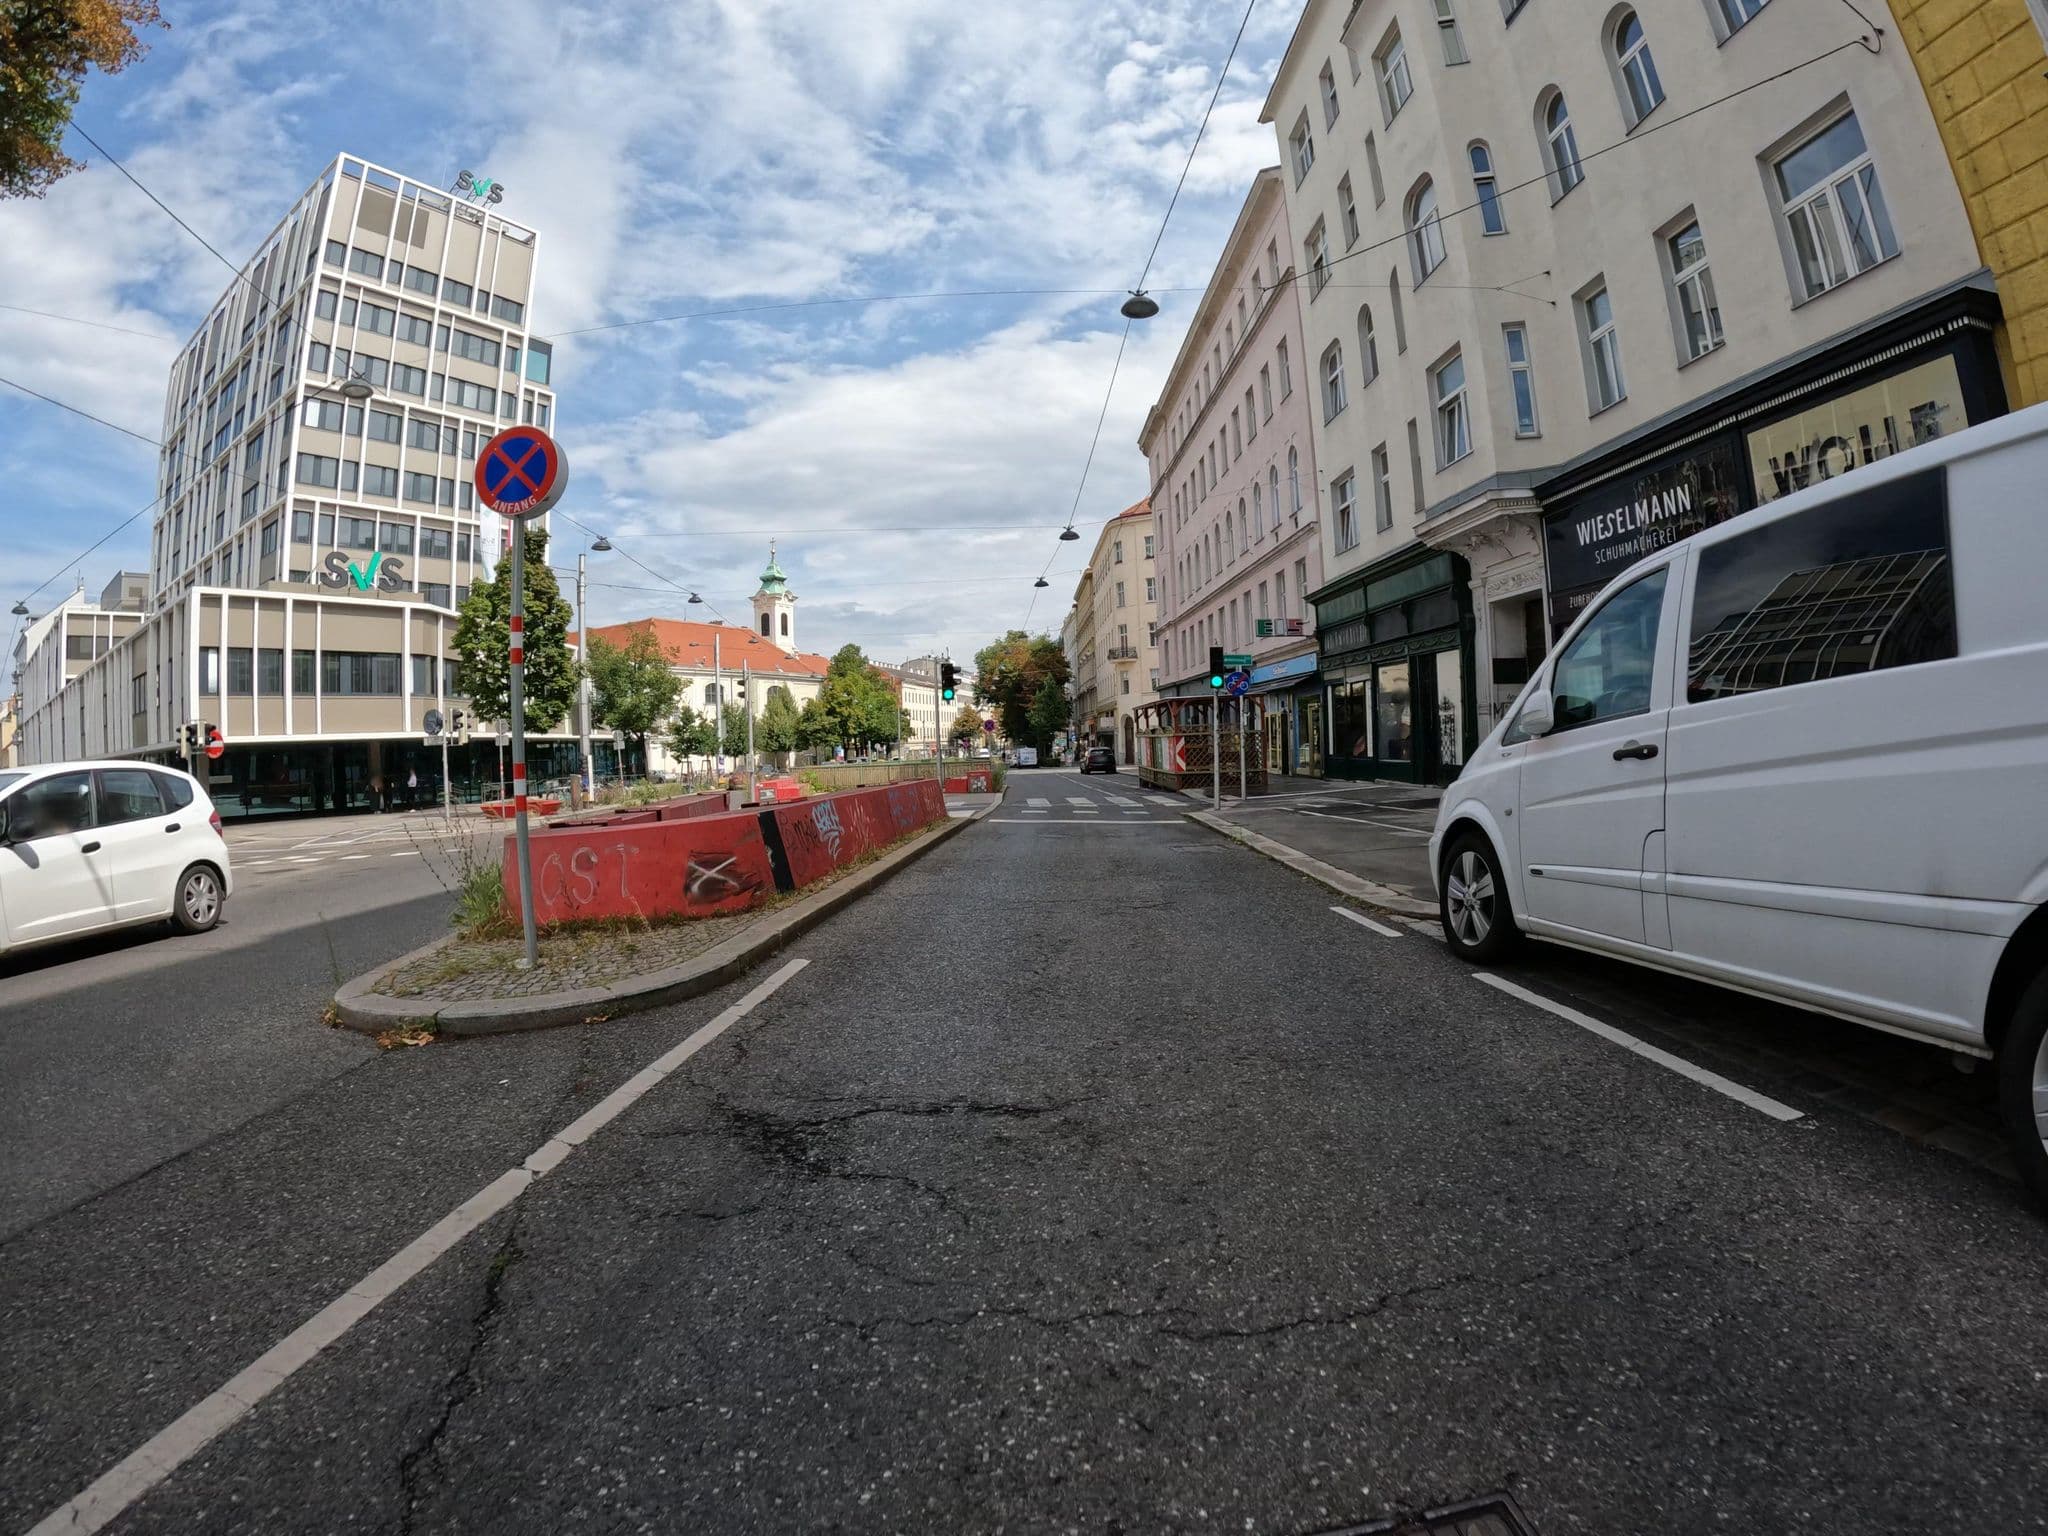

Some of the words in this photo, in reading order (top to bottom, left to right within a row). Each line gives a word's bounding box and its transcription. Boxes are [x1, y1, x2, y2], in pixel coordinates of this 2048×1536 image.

[491, 494, 537, 512] ANFANG
[1576, 483, 1691, 546] WIESELMANN
[1595, 526, 1676, 565] SCHUHMACHEREI
